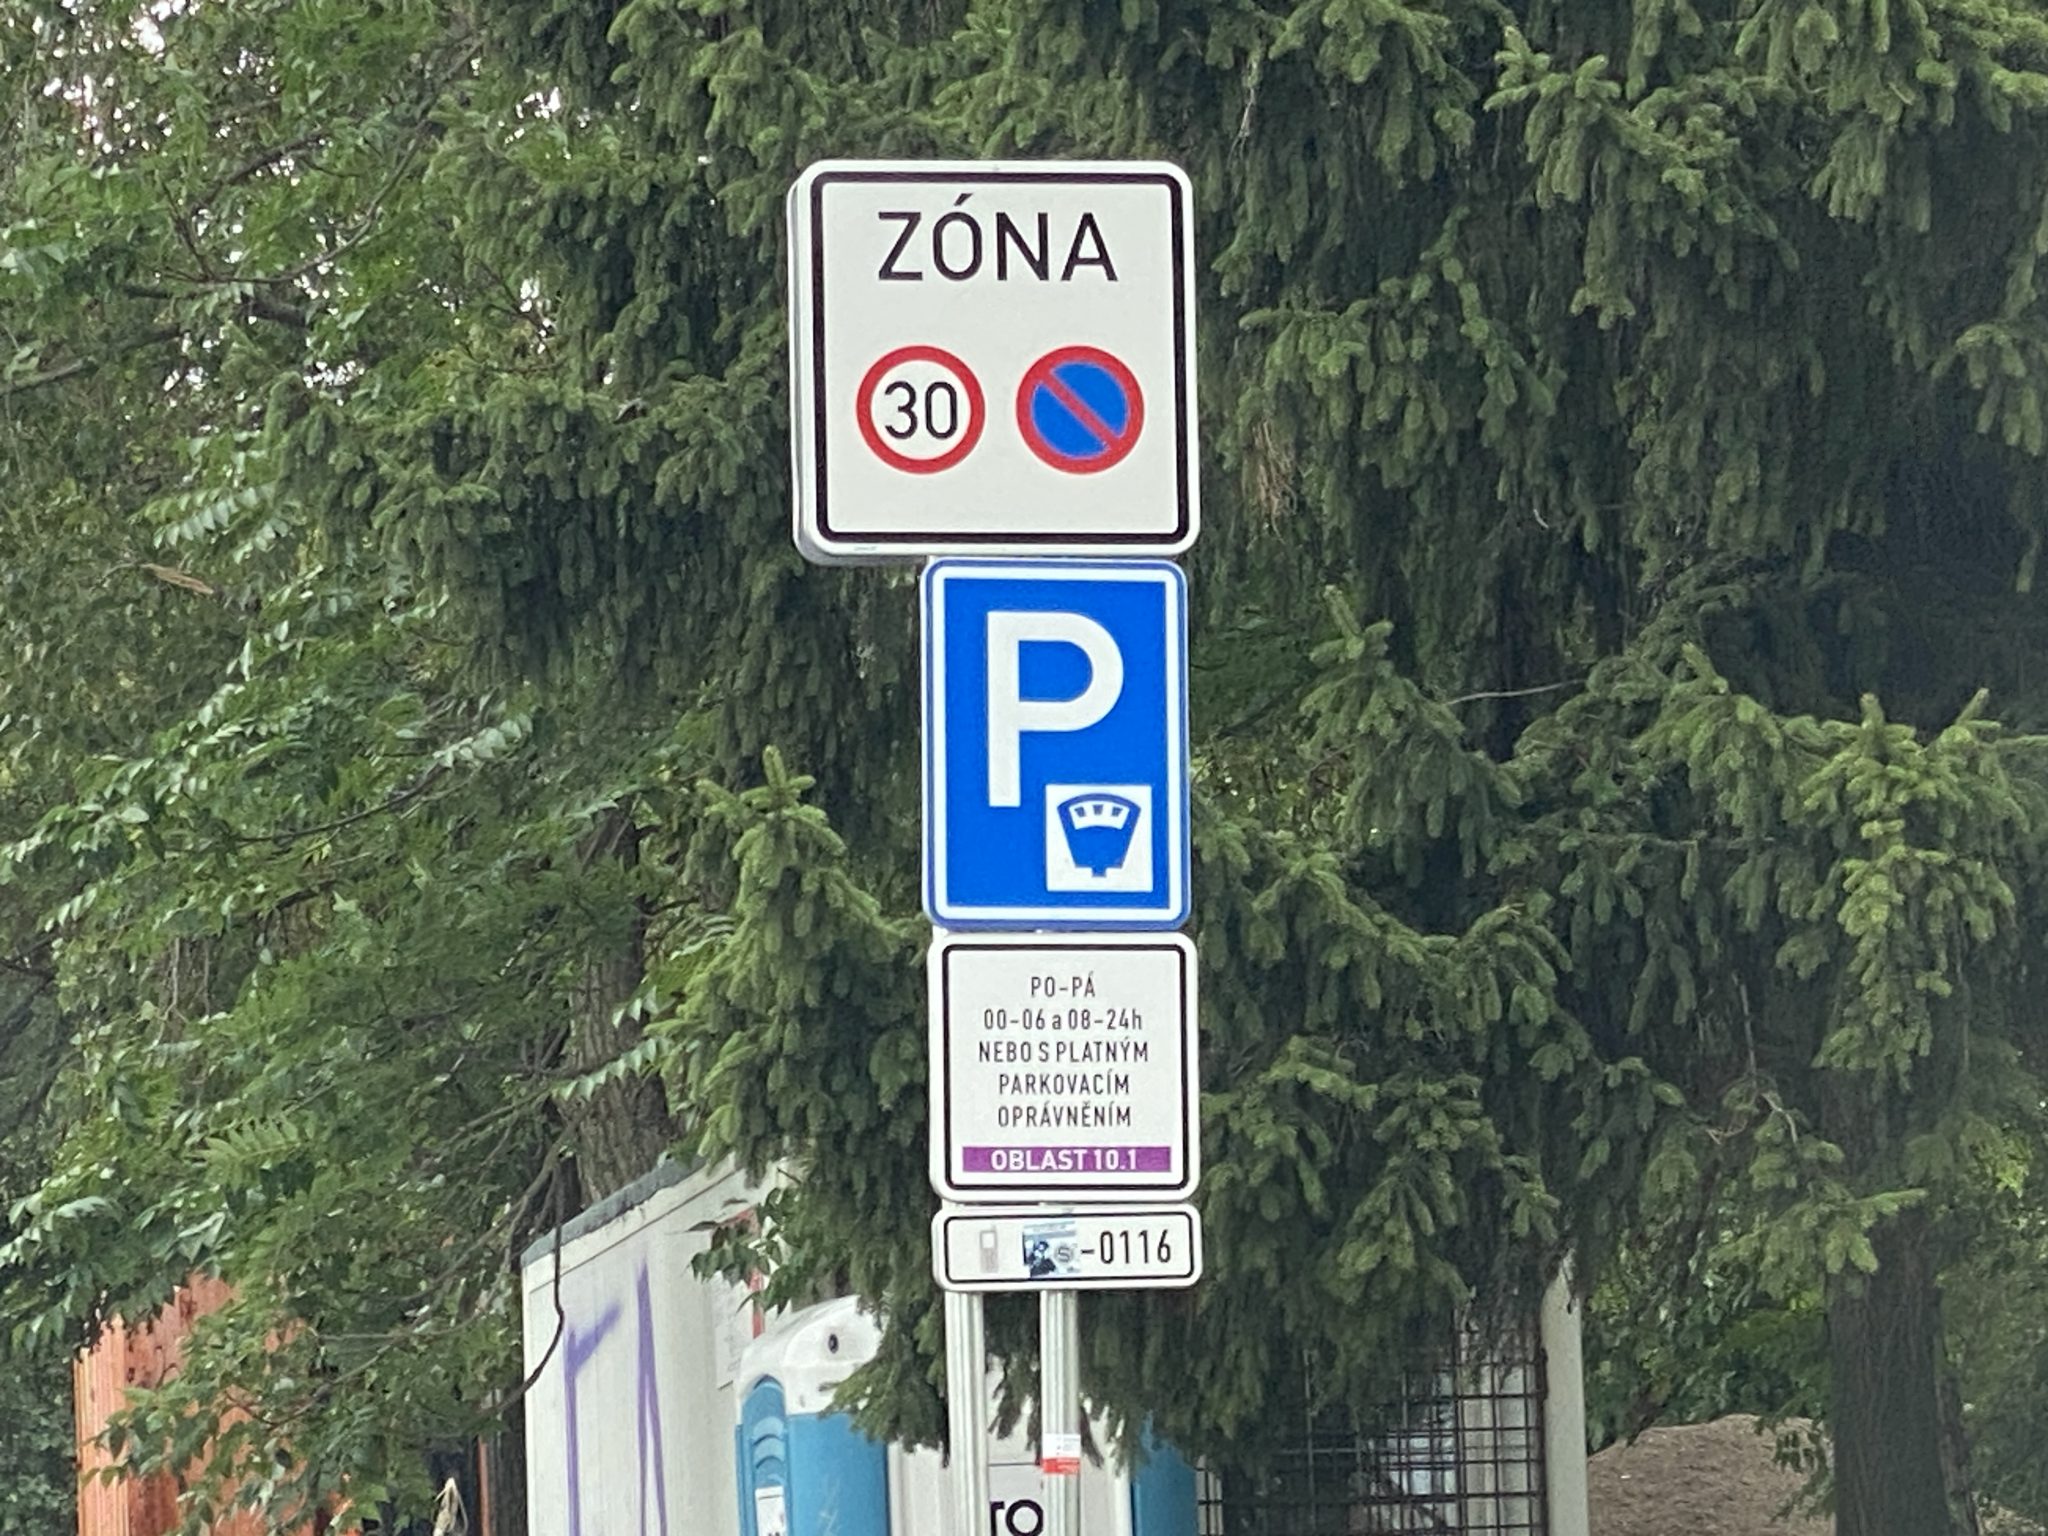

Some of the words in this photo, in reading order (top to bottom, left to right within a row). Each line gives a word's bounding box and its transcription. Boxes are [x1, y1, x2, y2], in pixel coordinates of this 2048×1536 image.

[878, 193, 1118, 281] ZÓNA
[884, 381, 958, 440] 30
[987, 611, 1124, 807] P
[1031, 971, 1096, 998] PO-PÁ
[984, 1008, 1046, 1030] 00-06
[1052, 1014, 1062, 1030] a
[1068, 1008, 1142, 1030] 08-24h
[979, 1041, 1032, 1063] NEBO
[1038, 1041, 1050, 1063] S
[1056, 1036, 1148, 1063] PLATNÝM
[999, 1068, 1130, 1095] PARKOVACÍM
[998, 1100, 1132, 1127] OPRÁVNĚNÍM
[990, 1149, 1088, 1171] OBLAST
[1093, 1148, 1137, 1171] 10.1
